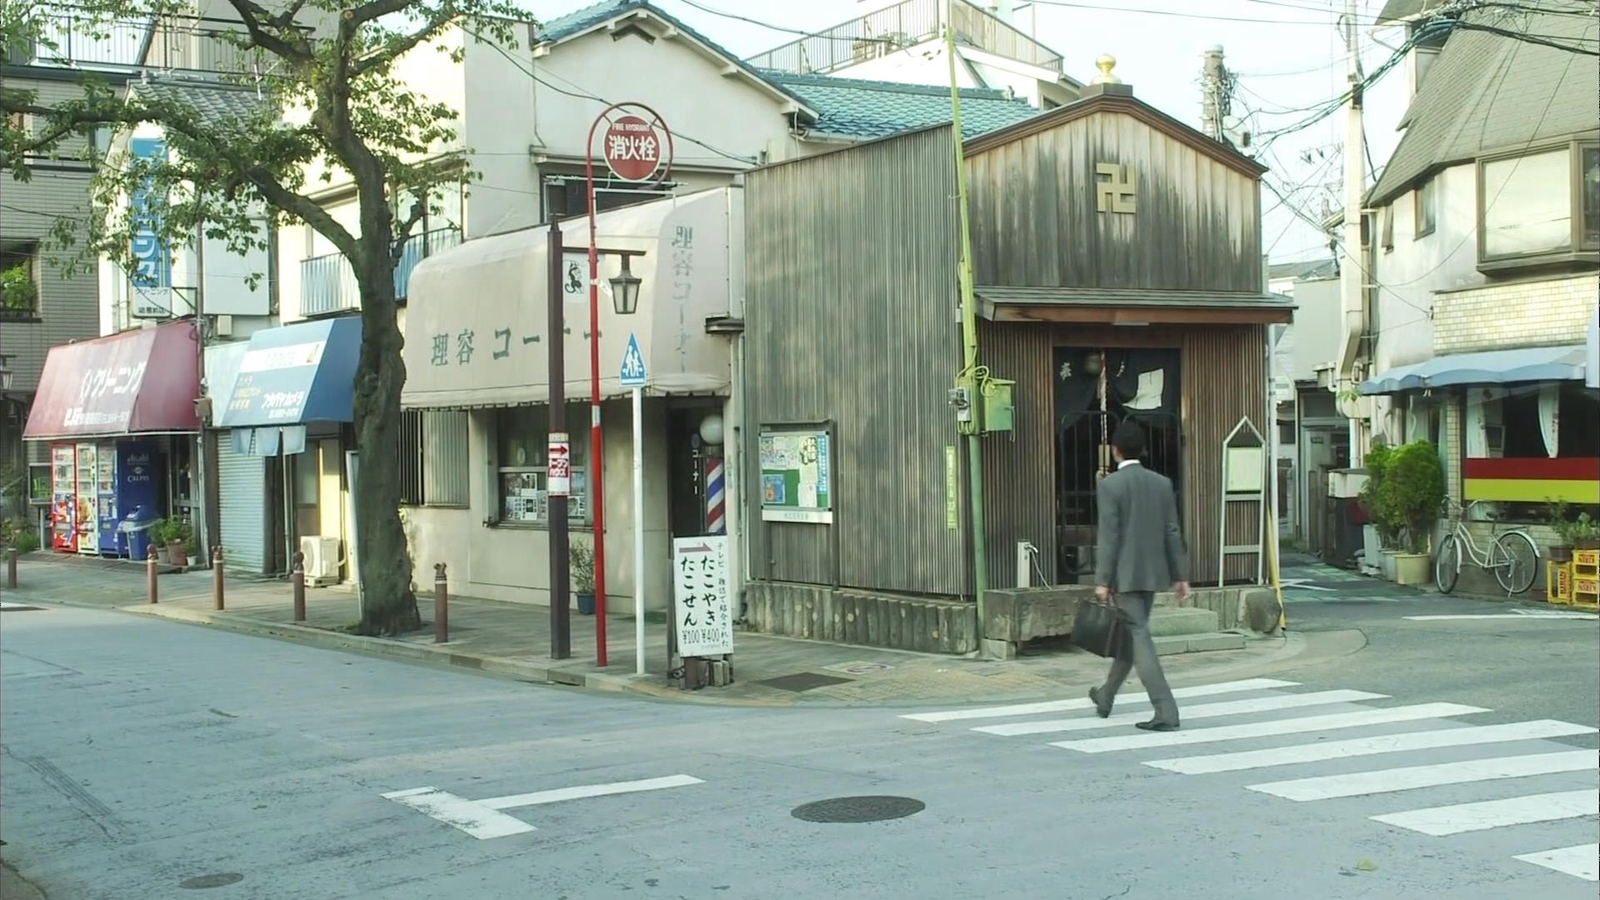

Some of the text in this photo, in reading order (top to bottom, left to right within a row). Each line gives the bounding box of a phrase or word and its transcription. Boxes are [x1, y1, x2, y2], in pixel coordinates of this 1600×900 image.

[612, 123, 625, 131] FIRE
[608, 134, 657, 161] 消火栓
[671, 225, 693, 373] 理容コーナー
[431, 326, 603, 367] 理容コーー
[91, 360, 147, 398] クリーニング
[680, 556, 698, 627] たこせん
[701, 555, 717, 626] たこやき
[682, 629, 700, 645] ¥100
[701, 628, 720, 643] ¥400
